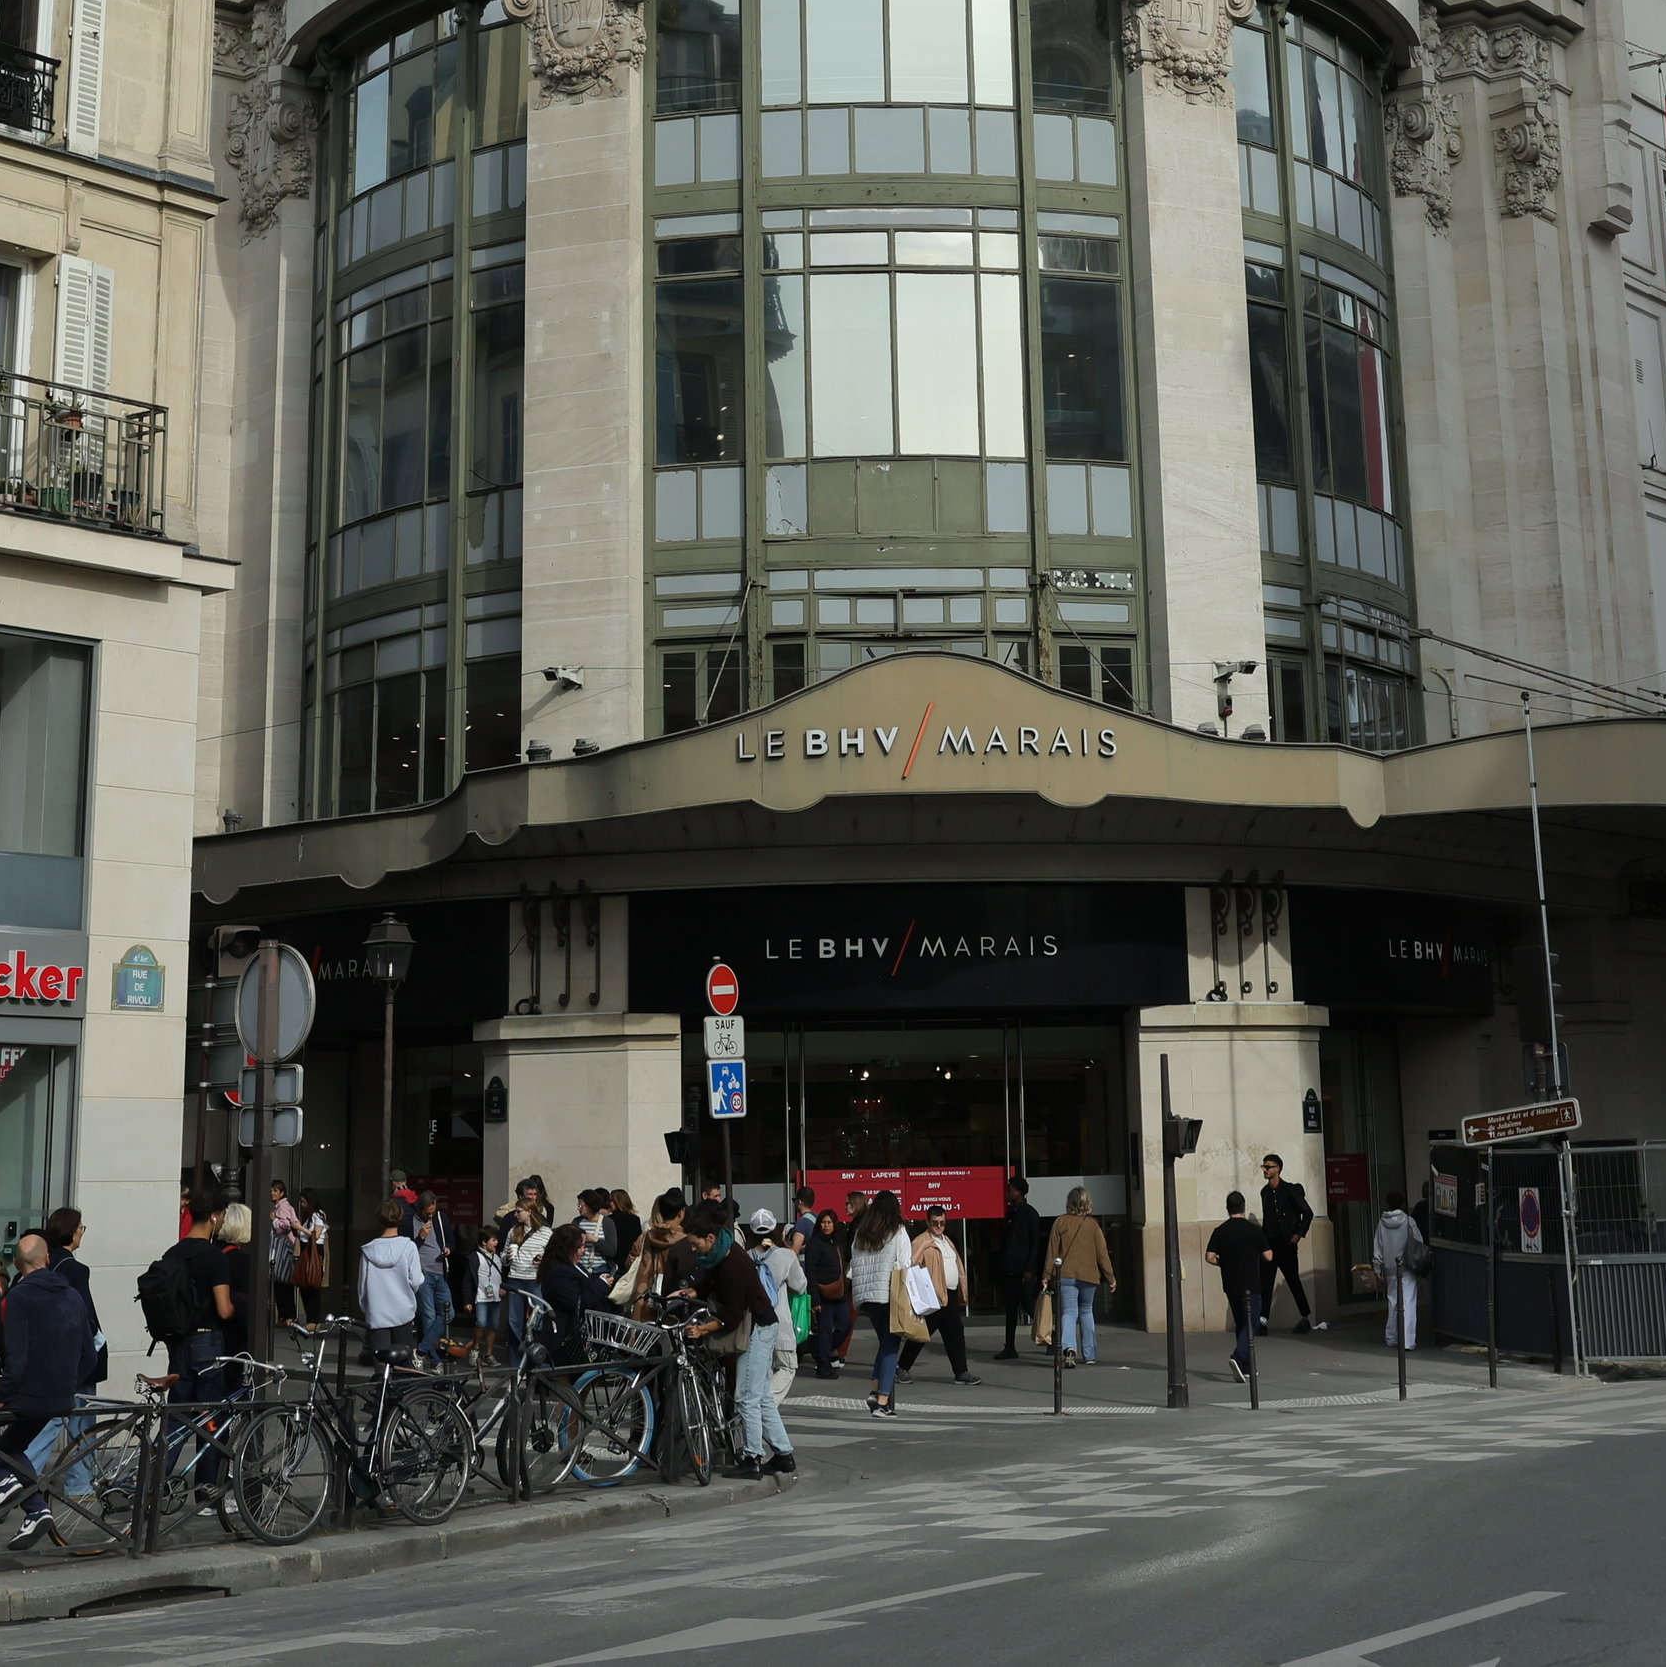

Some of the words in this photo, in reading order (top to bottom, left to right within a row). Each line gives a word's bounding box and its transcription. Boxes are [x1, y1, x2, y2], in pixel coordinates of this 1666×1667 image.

[738, 730, 785, 760] LE
[805, 725, 900, 758] BHV
[938, 725, 1118, 758] MARAIS
[765, 936, 802, 960] LE
[819, 936, 890, 960] BHV
[919, 934, 1060, 959] MARAIS
[1388, 938, 1408, 958] LE
[1414, 941, 1443, 961] BHV
[133, 970, 148, 979] RUE
[134, 983, 144, 991] DE
[127, 995, 151, 1005] RIVOLI
[715, 1020, 735, 1029] SAUF
[1488, 1116, 1505, 1124] Musée
[1516, 1125, 1534, 1135] Temple
